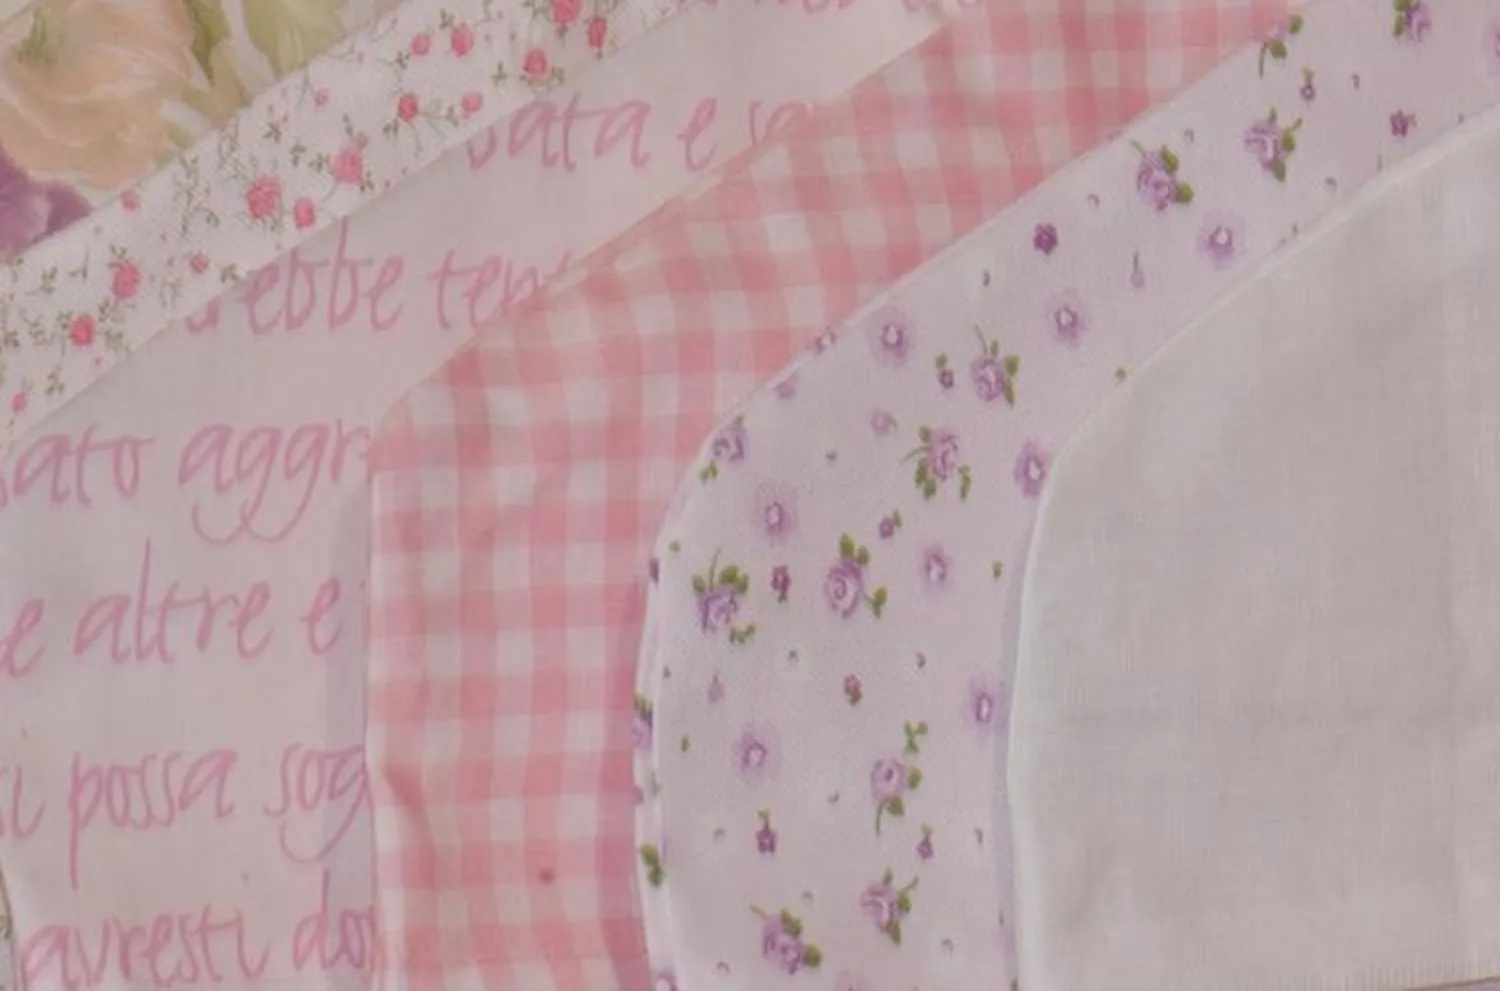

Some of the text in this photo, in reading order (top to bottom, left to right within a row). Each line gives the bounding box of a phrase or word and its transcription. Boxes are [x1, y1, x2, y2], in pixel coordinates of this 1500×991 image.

[0, 423, 156, 507] ato
[72, 537, 276, 663] altre
[68, 749, 239, 893] possa
